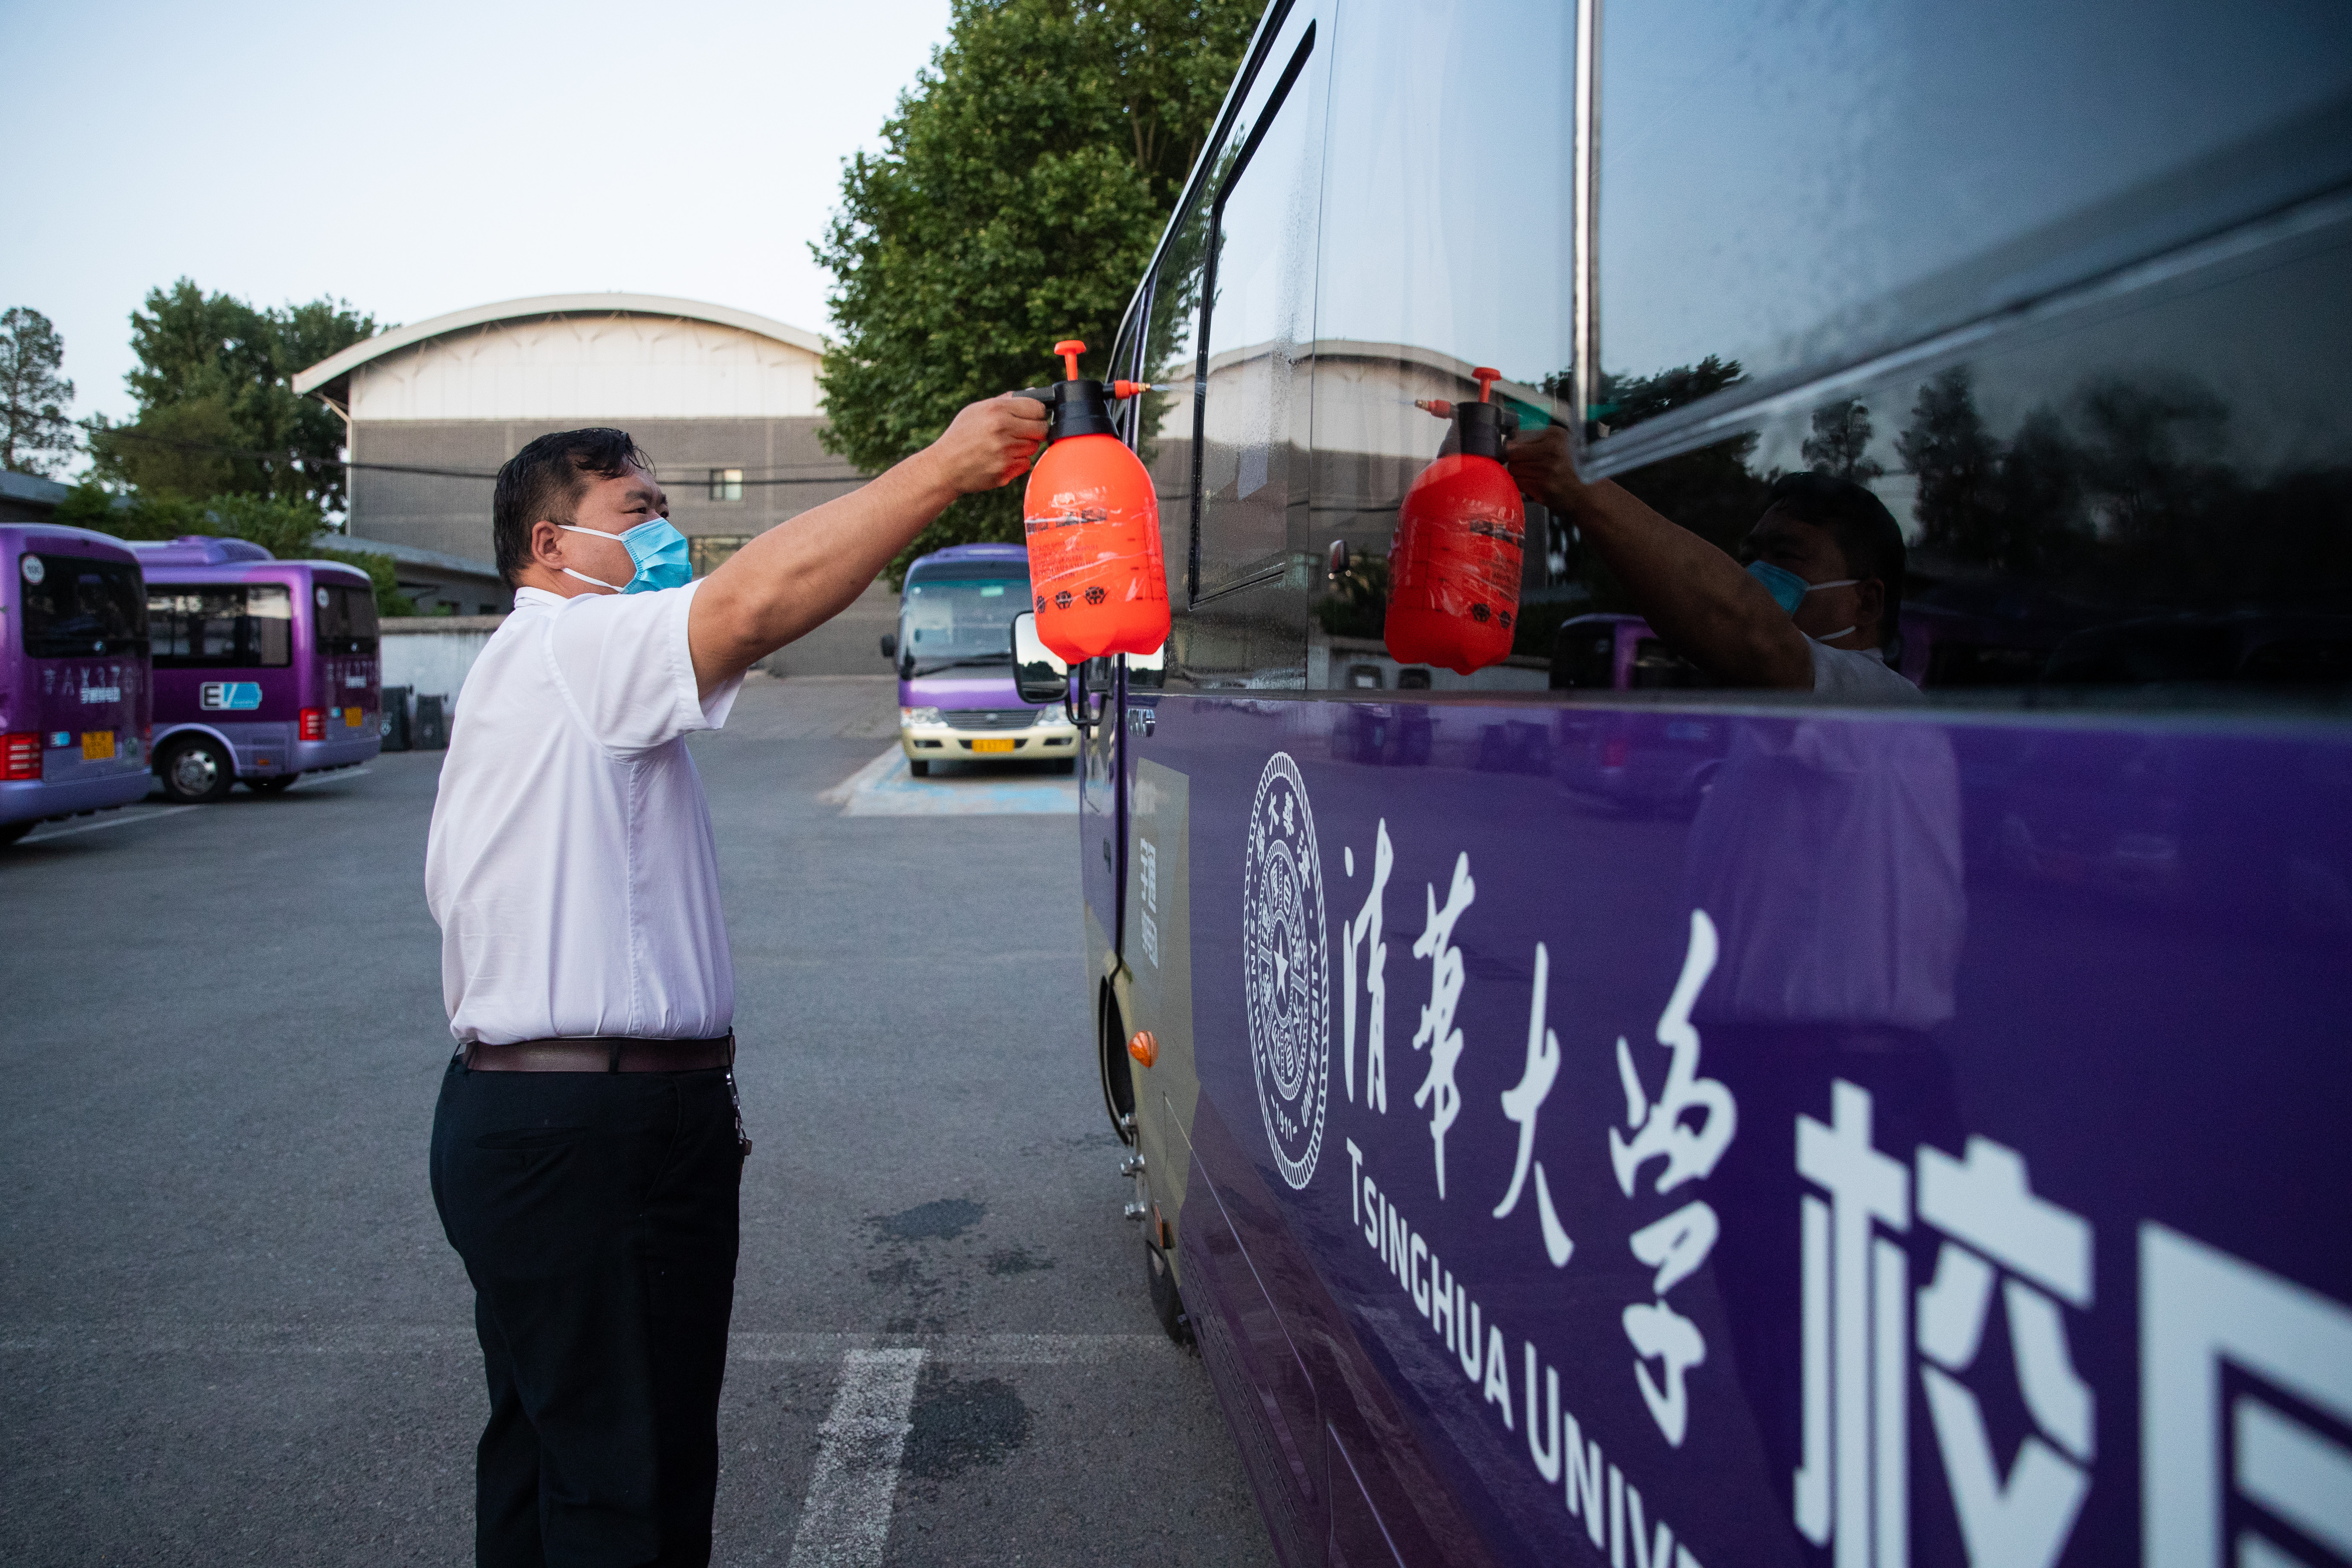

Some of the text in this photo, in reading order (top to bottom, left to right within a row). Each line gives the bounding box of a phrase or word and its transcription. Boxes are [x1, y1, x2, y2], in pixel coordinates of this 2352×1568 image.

[1250, 897, 1319, 1128] TSINGHUA UNIVERSITY
[1346, 1136, 1514, 1431] TSINGHUA
